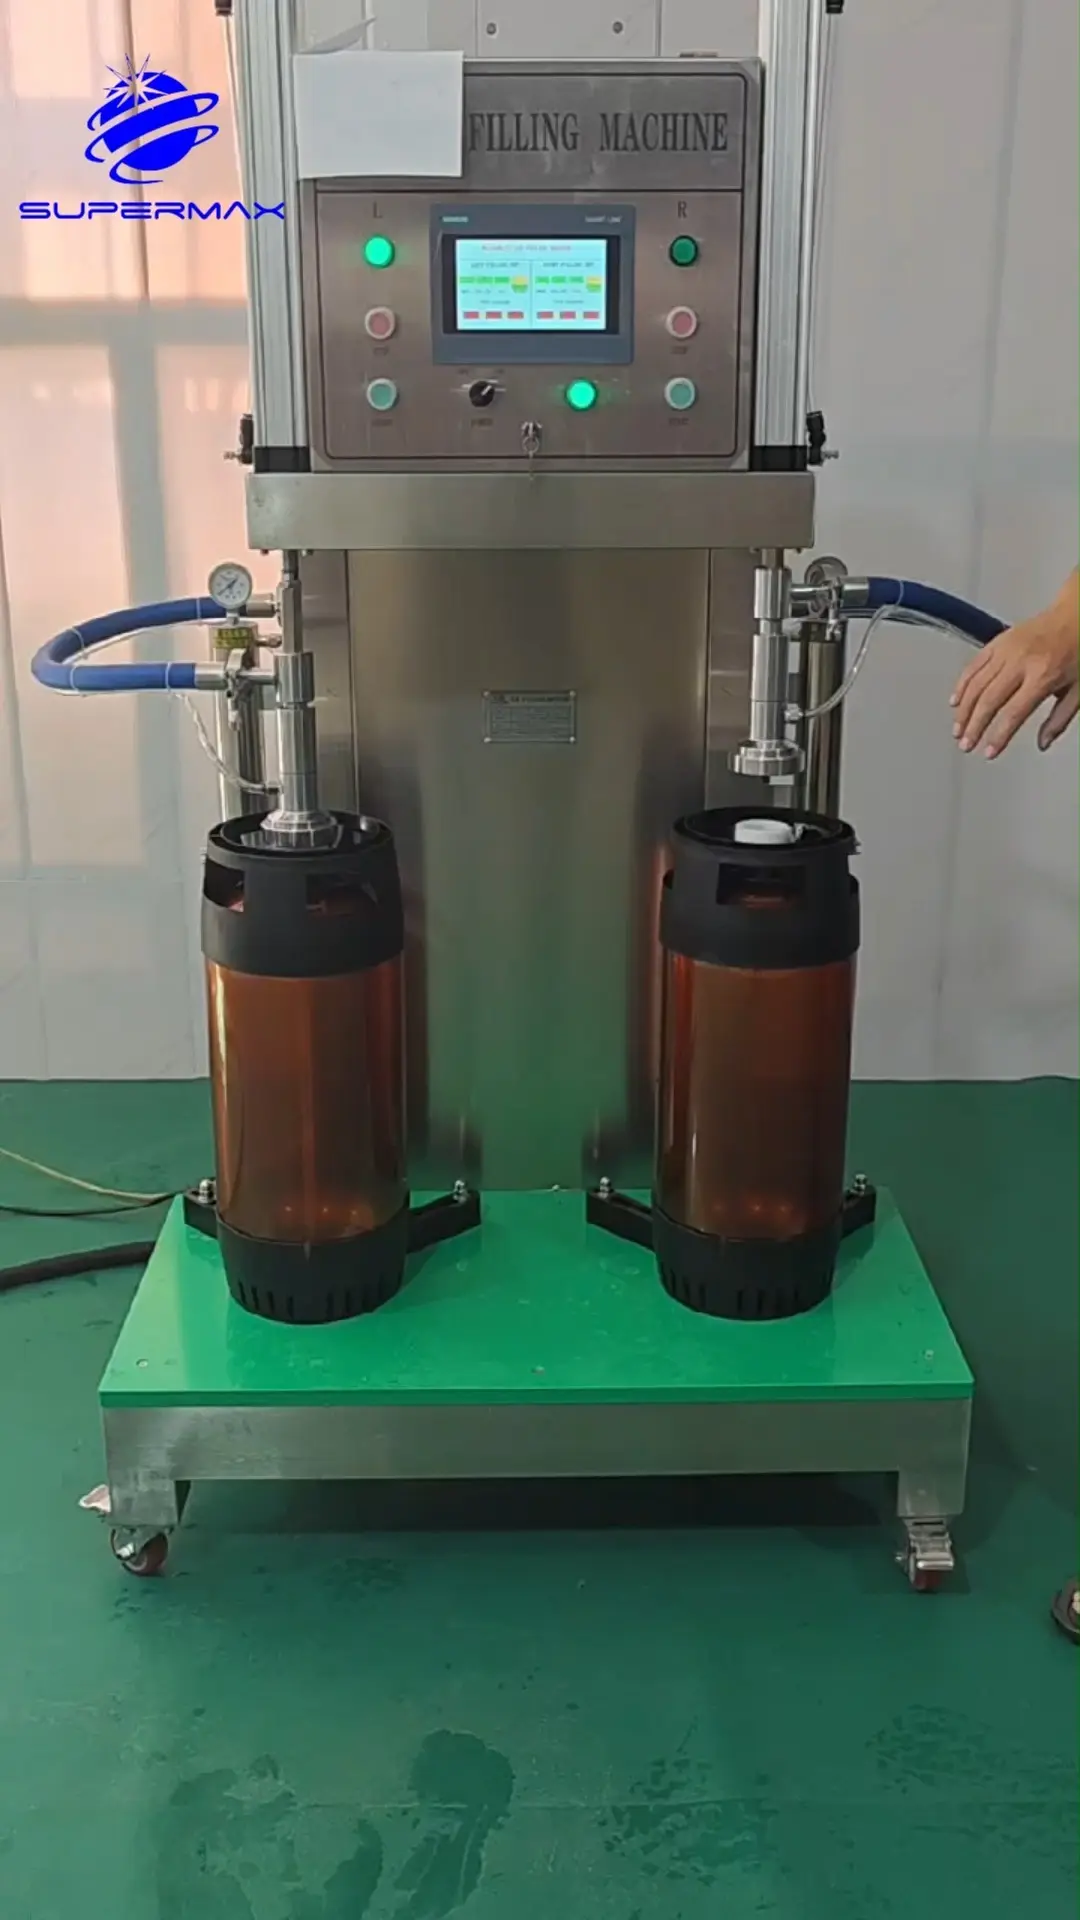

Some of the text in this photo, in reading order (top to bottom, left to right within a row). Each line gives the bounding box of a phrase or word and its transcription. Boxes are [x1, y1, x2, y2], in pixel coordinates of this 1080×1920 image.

[469, 112, 728, 152] FILLING MACHINE
[372, 201, 383, 219] L
[677, 200, 688, 219] R
